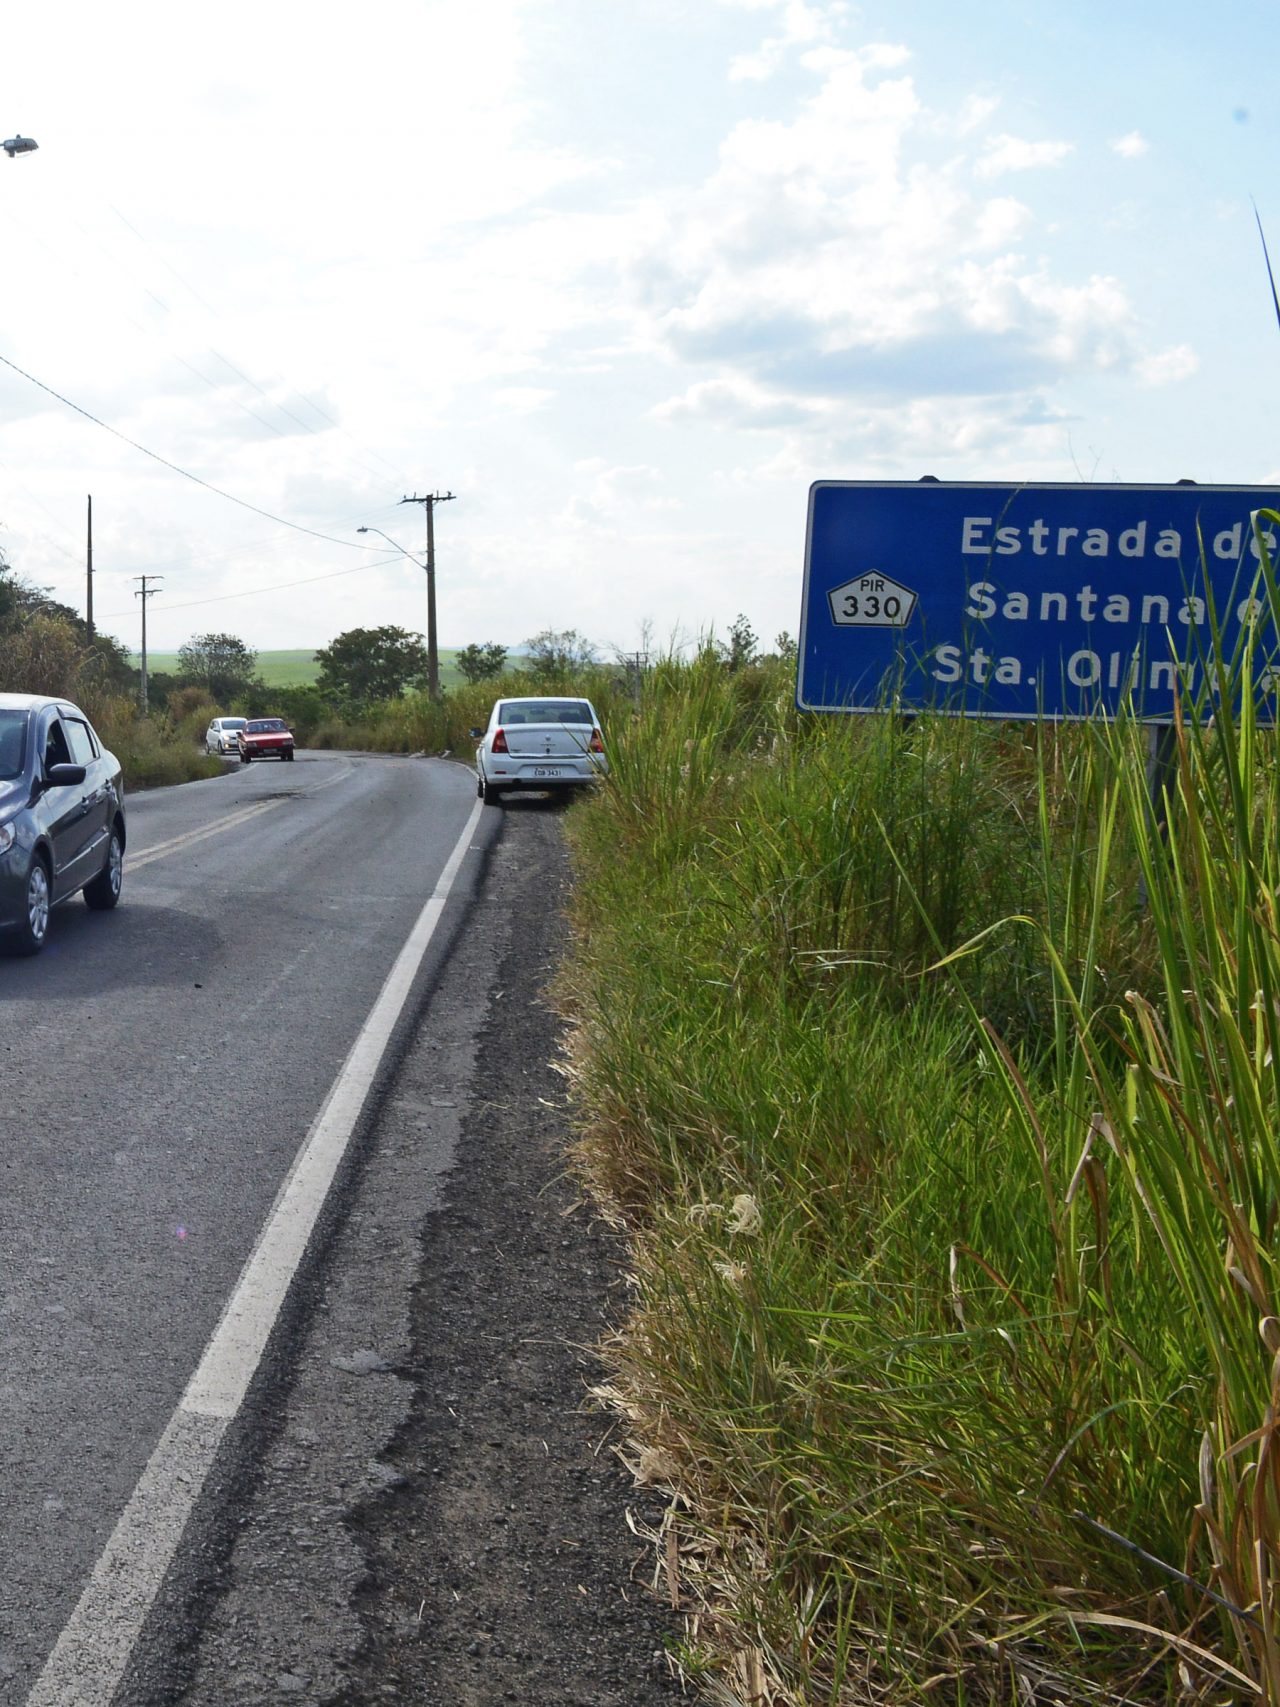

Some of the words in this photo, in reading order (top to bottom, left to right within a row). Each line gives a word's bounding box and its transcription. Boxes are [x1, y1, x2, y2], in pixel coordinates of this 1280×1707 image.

[961, 517, 1181, 558] Estrada
[1213, 522, 1277, 559] de
[842, 595, 900, 618] 330
[860, 579, 884, 592] PIR
[965, 582, 1205, 624] Santana
[931, 645, 1037, 685] Sta.
[1067, 650, 1280, 700] Olimpa
